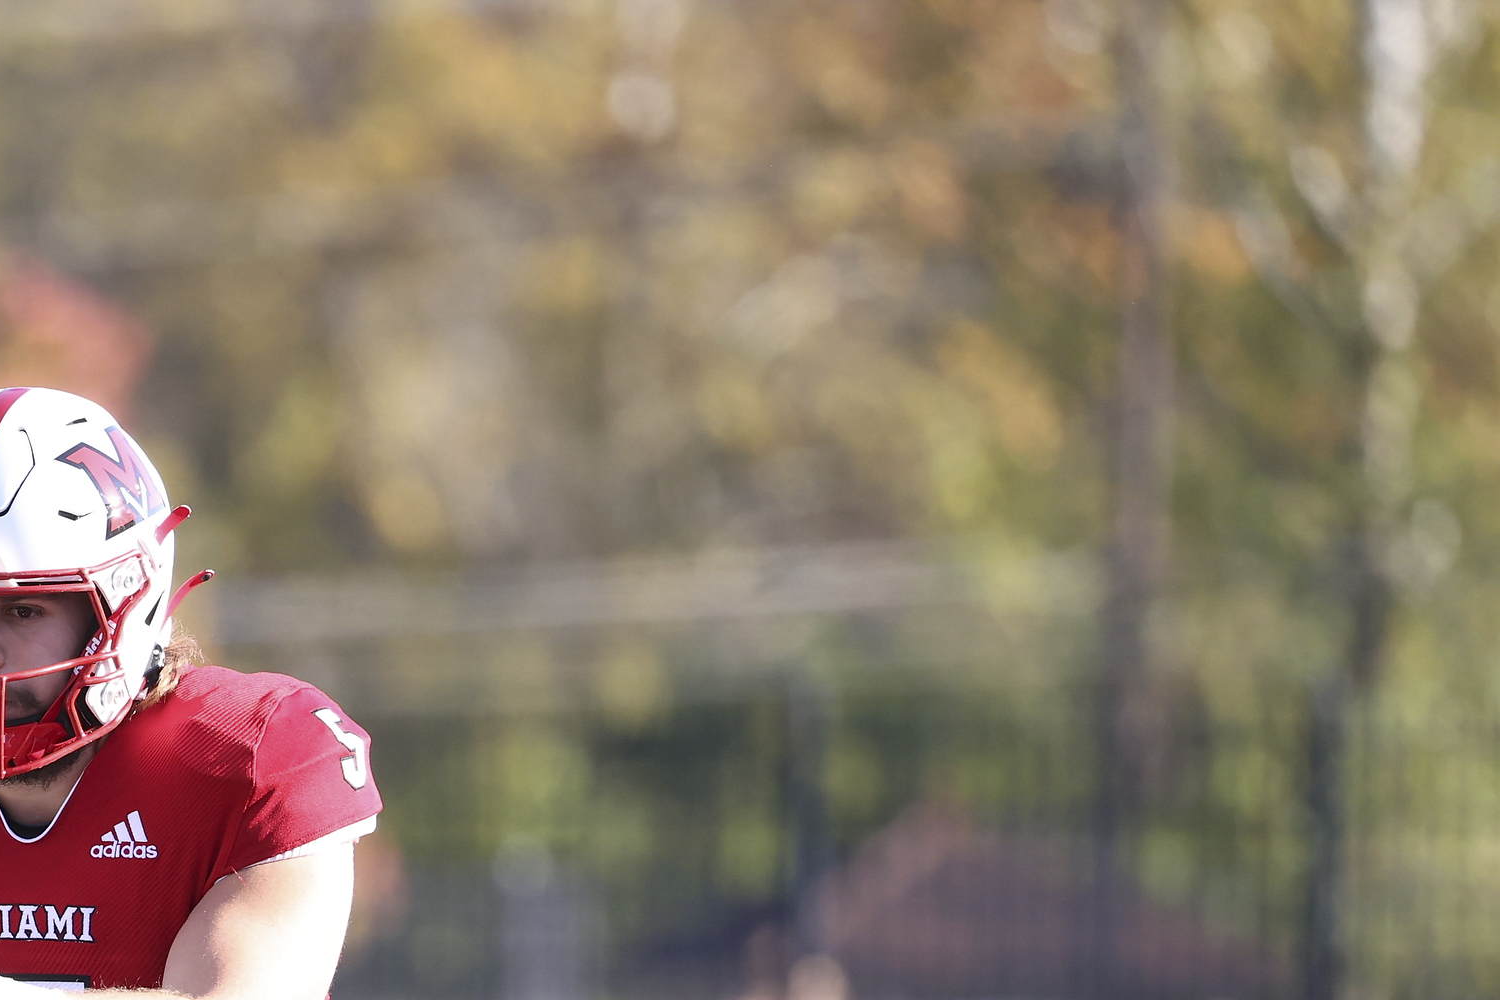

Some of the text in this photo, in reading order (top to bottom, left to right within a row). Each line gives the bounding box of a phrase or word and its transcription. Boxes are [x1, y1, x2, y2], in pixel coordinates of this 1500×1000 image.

[54, 425, 166, 541] M
[311, 707, 367, 791] 5
[90, 840, 158, 859] adidas
